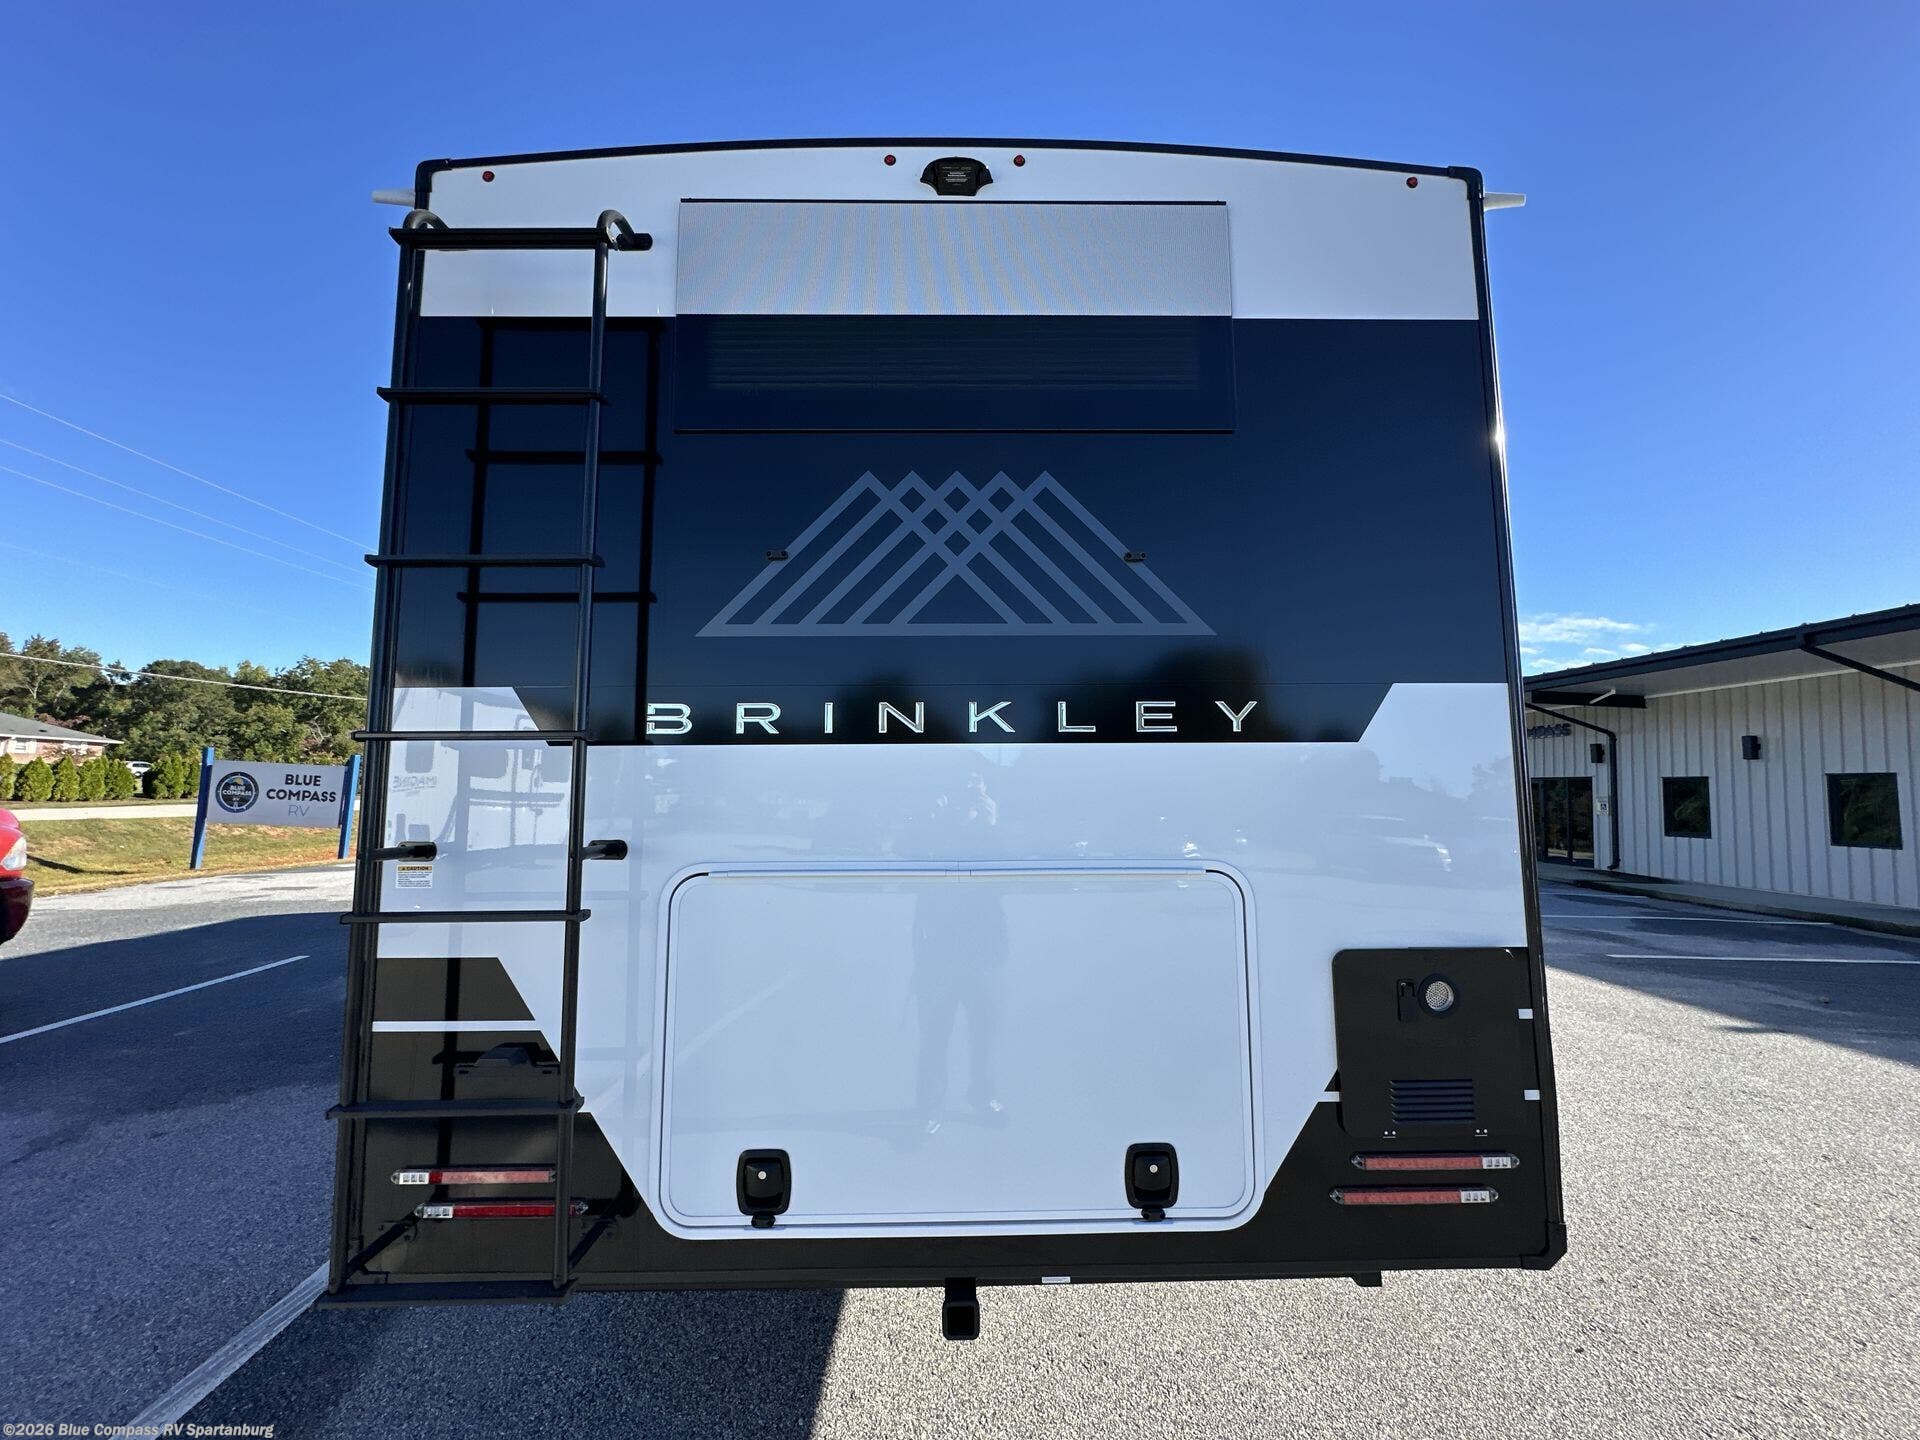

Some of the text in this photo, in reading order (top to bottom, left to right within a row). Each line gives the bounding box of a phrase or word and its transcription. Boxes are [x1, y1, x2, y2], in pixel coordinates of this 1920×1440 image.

[646, 700, 1258, 735] BRINKLEY
[285, 774, 322, 787] BLUE
[266, 788, 336, 803] COMPASS
[288, 804, 310, 817] RV
